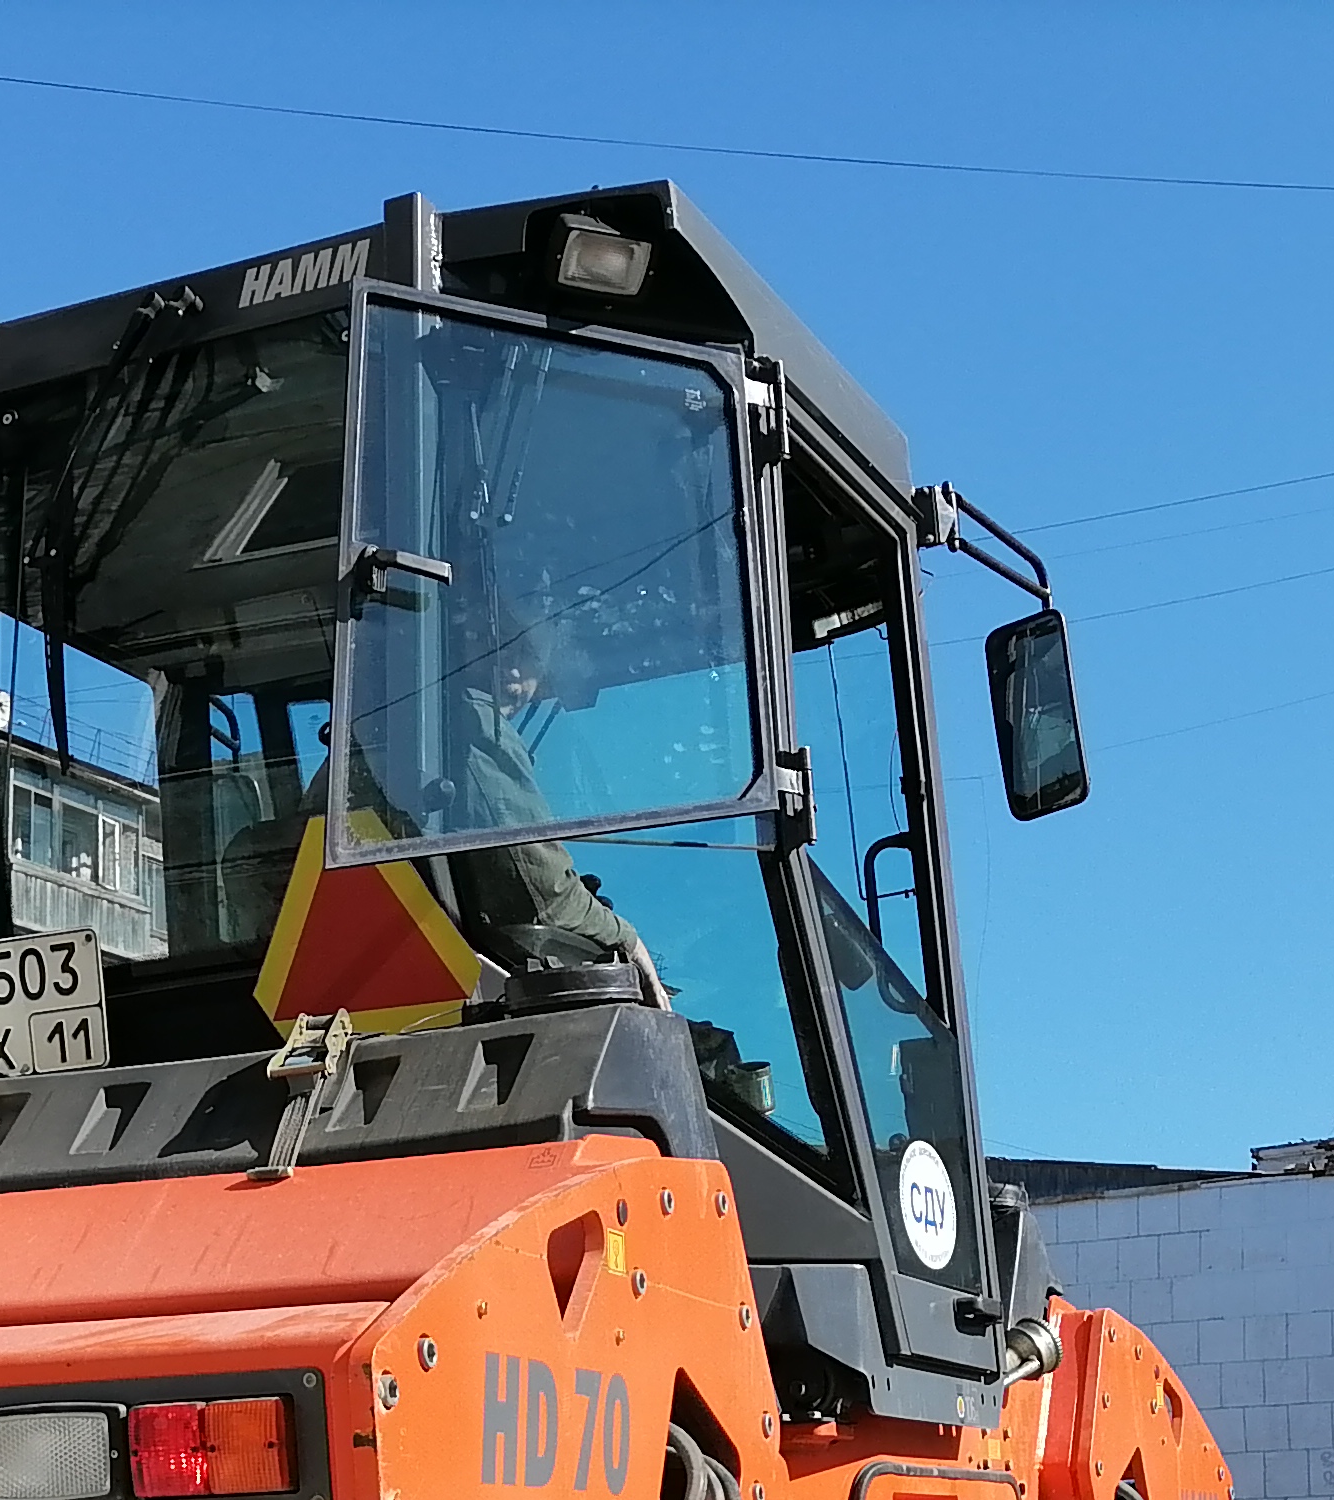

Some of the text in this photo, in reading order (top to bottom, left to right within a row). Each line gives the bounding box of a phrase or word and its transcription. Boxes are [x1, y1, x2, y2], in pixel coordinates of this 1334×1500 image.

[238, 238, 371, 309] HAMM
[46, 1017, 93, 1063] 11
[910, 1181, 946, 1236] СДУ
[480, 1351, 630, 1496] HD 70
